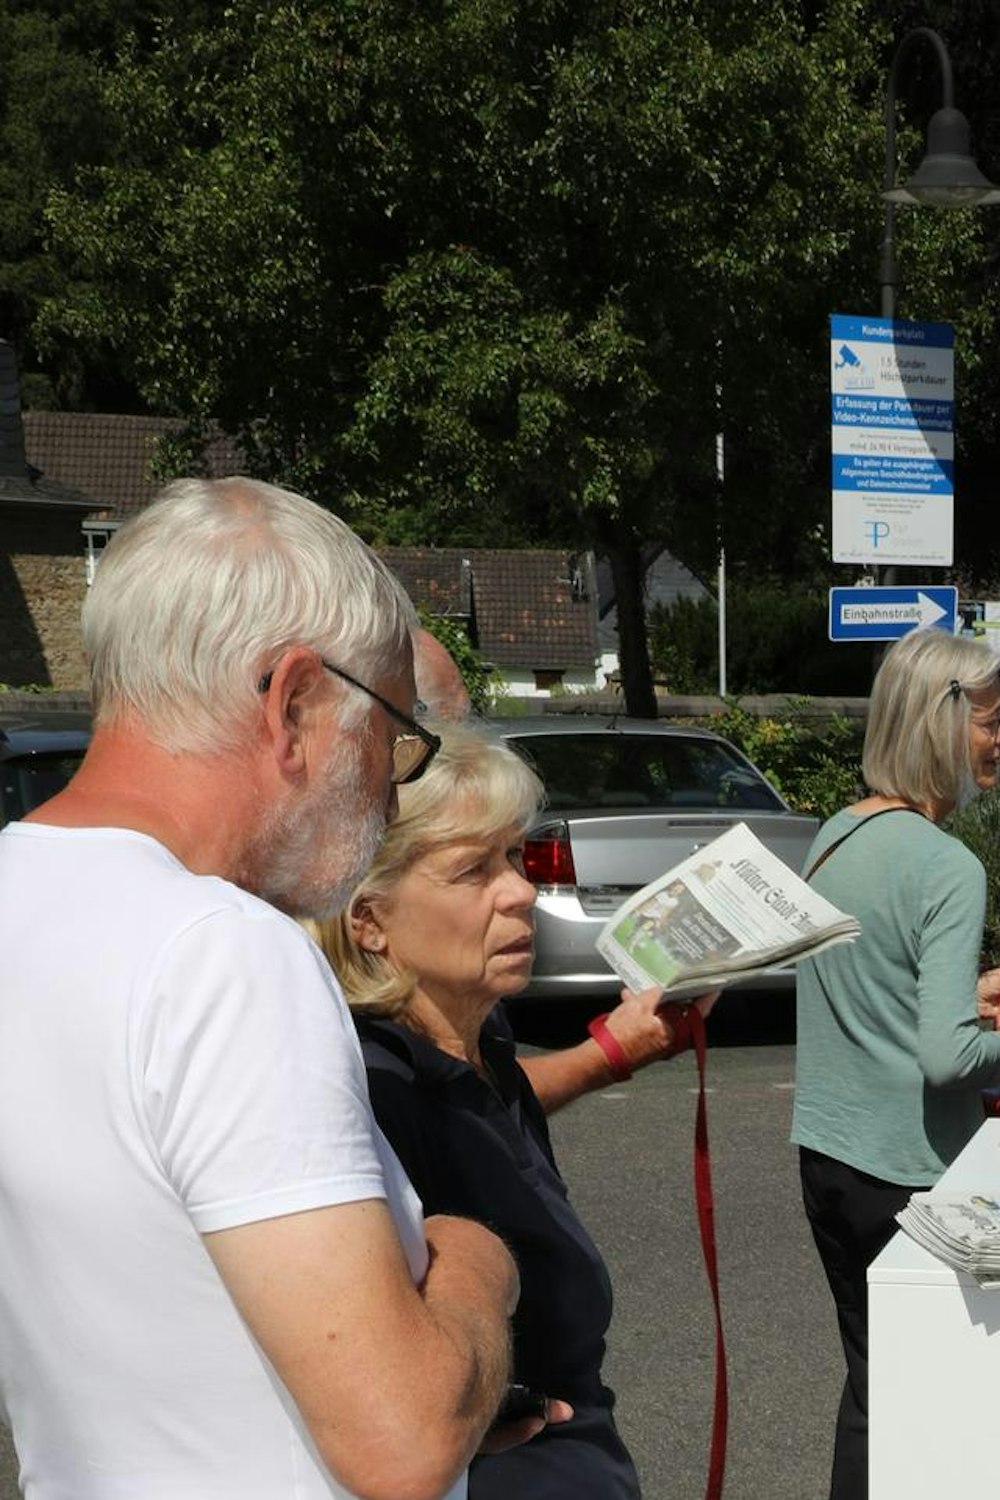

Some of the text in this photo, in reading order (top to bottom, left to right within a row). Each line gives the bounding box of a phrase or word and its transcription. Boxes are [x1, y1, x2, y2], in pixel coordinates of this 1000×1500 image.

[836, 397, 877, 412] Erfassung
[879, 400, 892, 410] der
[843, 607, 922, 621] Einbahnstraße
